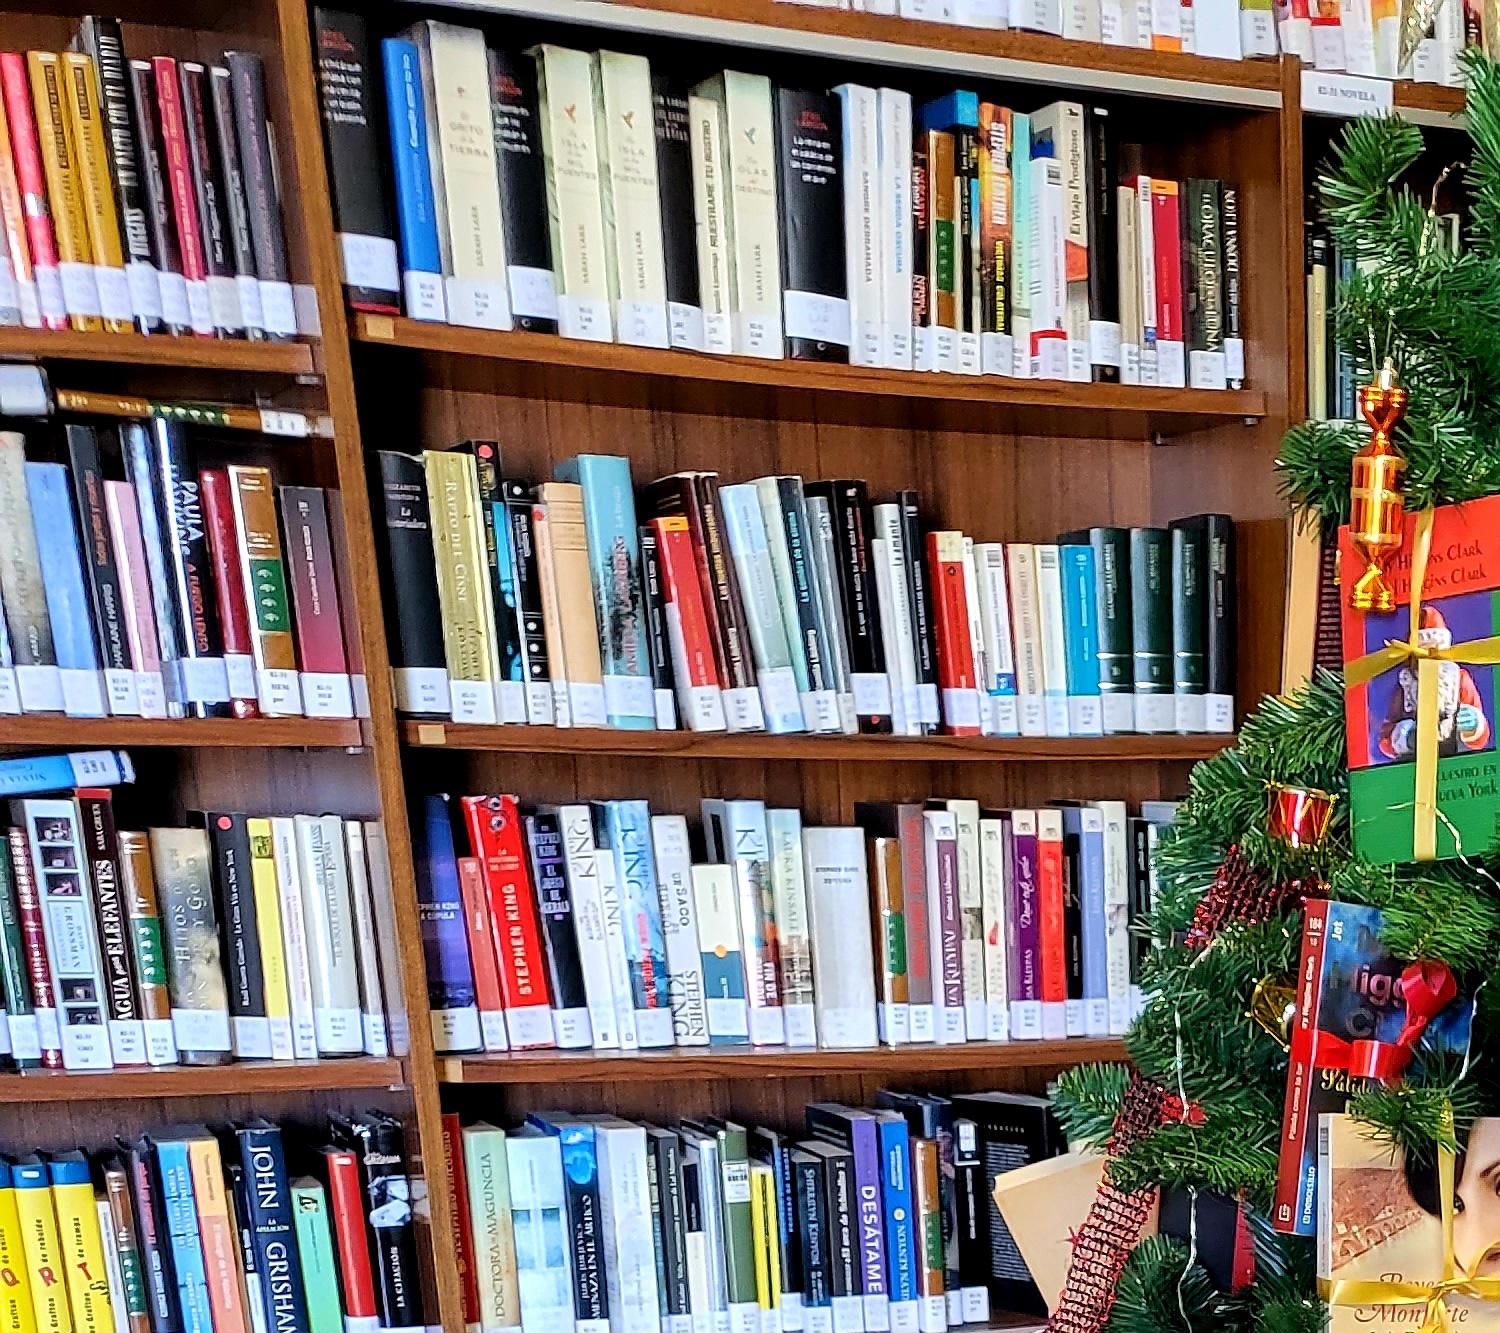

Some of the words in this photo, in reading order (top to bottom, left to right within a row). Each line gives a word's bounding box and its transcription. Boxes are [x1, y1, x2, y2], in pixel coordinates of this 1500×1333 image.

[182, 482, 204, 541] PAULA
[96, 860, 124, 956] ELEFANTES
[502, 883, 519, 922] KING
[1331, 921, 1344, 941] Jet
[509, 927, 532, 995] STEPHEN
[112, 976, 133, 1020] AGUA
[686, 971, 705, 1037] STEPHEN
[249, 1145, 279, 1208] JOHN
[481, 1152, 497, 1236] MAGUNCIA
[861, 1185, 883, 1292] DESÁTAME
[488, 1248, 504, 1317] DOCTORA
